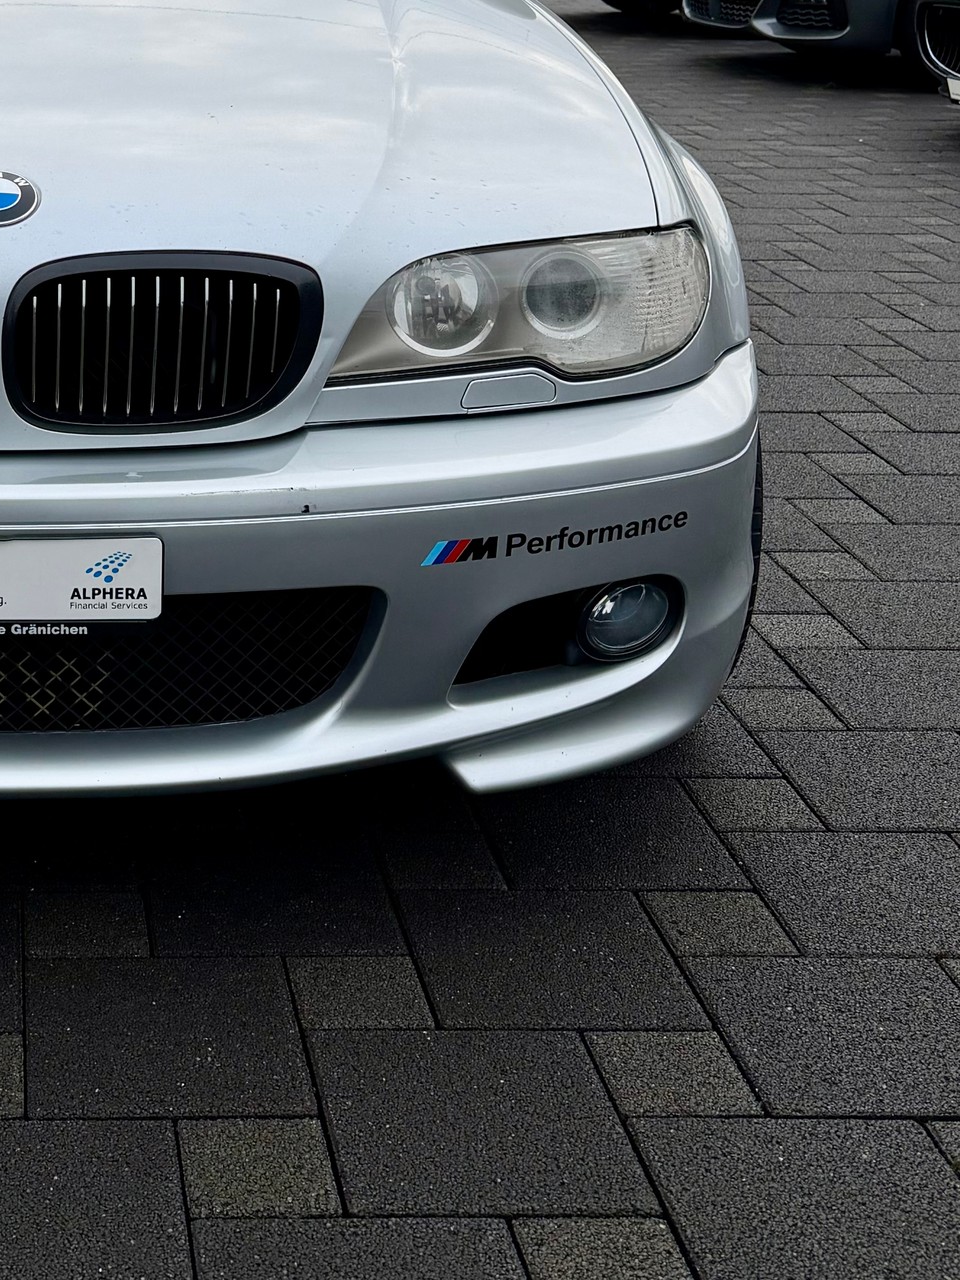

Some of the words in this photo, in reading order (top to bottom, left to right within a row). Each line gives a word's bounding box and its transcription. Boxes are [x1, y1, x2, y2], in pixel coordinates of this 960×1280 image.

[505, 510, 689, 557] Performance
[70, 587, 148, 600] ALPHERA
[70, 601, 108, 609] Financial
[111, 601, 148, 610] Services
[11, 623, 88, 635] Gränichen
